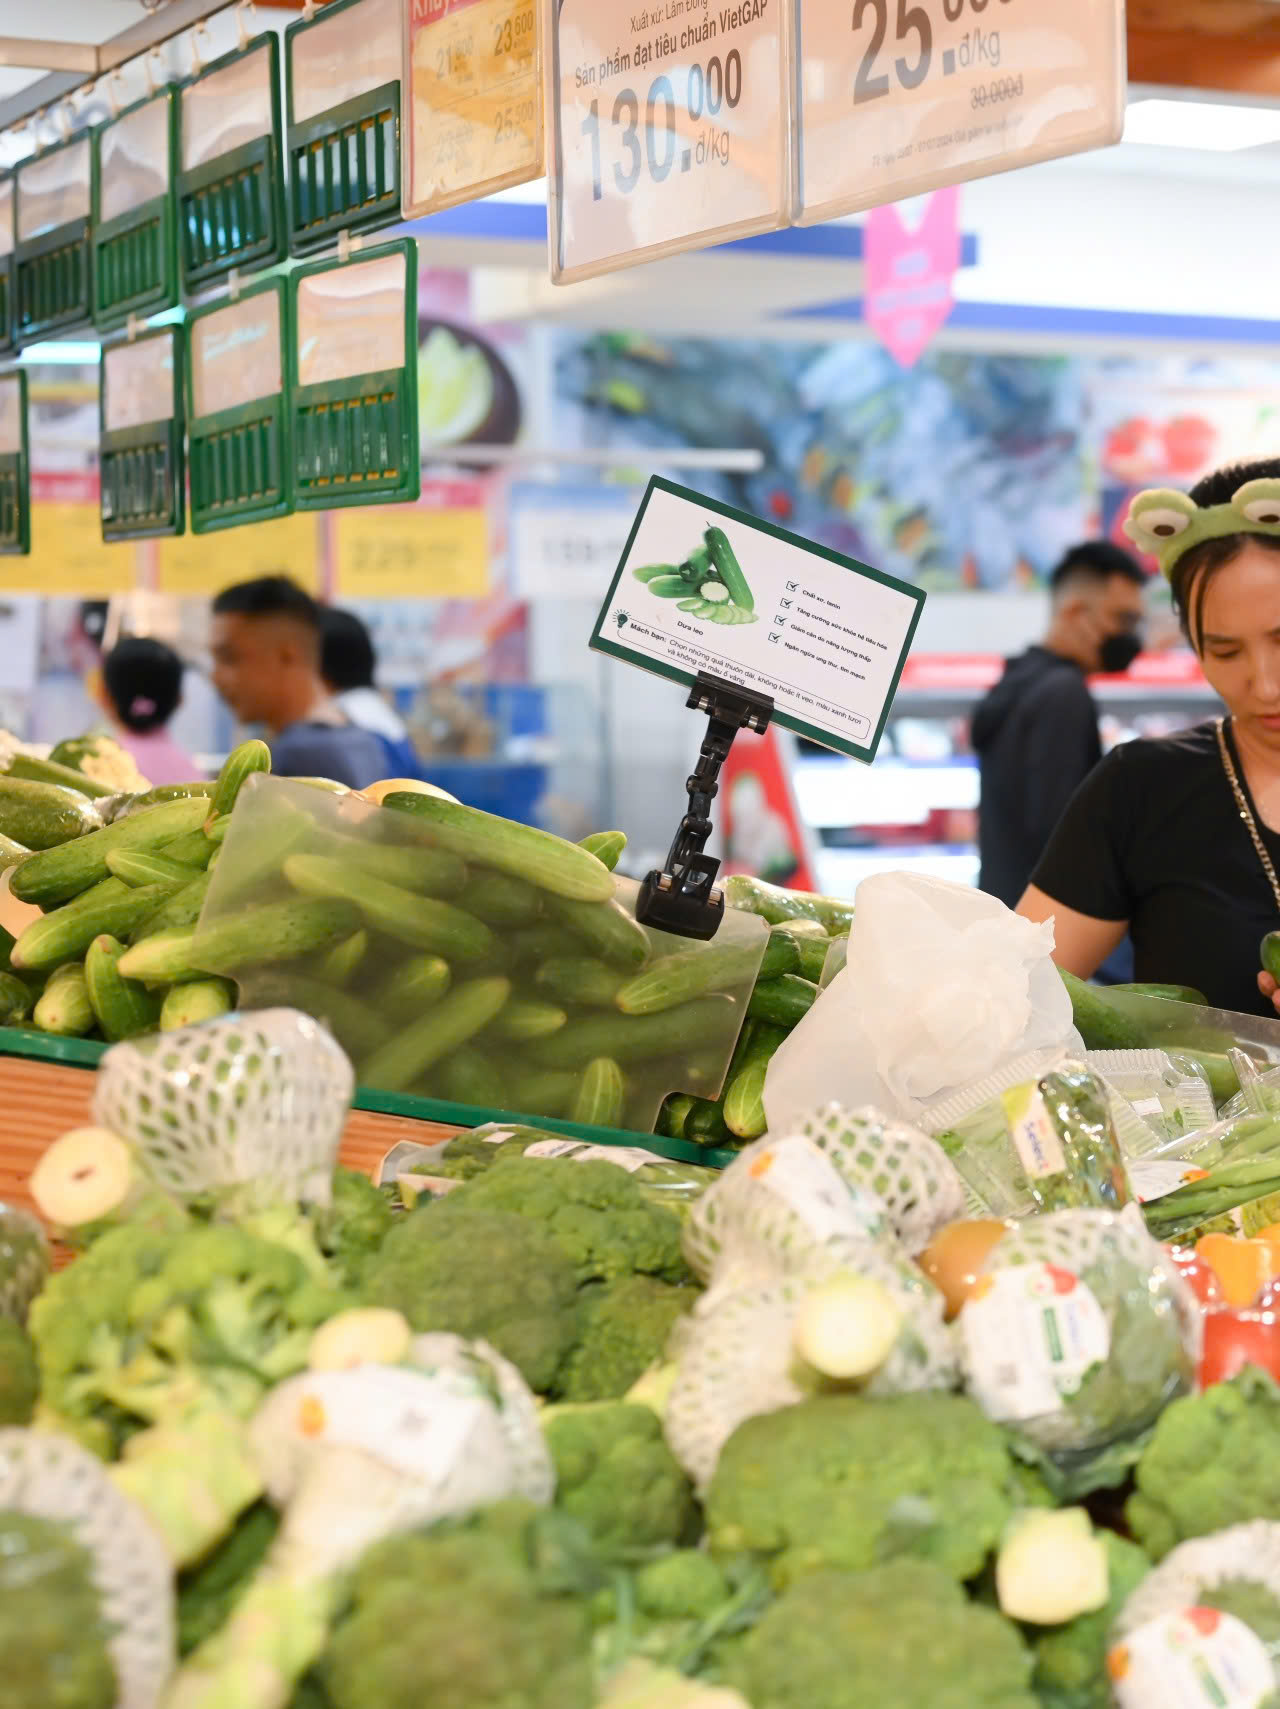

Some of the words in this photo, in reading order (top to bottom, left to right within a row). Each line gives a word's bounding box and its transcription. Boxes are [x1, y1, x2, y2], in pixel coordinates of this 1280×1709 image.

[630, 9, 649, 33] Xuất
[666, 0, 684, 20] Lâm
[575, 65, 596, 88] Sản
[599, 45, 631, 85] phẩm
[633, 42, 652, 70] đạt
[655, 33, 677, 58] tiêu
[680, 12, 717, 49] chuẩn
[719, 0, 768, 33] VietGAP
[958, 27, 1001, 67] đ/kg
[695, 128, 730, 167] đ/kg
[797, 607, 811, 617] Tăng
[802, 590, 816, 599] Chất
[677, 620, 692, 631] Dưa
[693, 627, 704, 636] leo
[630, 622, 650, 636] Mách
[651, 630, 667, 643] bạn:
[669, 639, 688, 651] Chọn
[688, 647, 710, 661] những
[711, 656, 724, 667] quả
[725, 662, 744, 674] thuôn
[758, 676, 778, 690] không
[778, 682, 795, 696] hoặc
[816, 701, 830, 712] màu
[831, 708, 847, 719] xanh
[847, 715, 861, 725] tươi
[667, 648, 676, 656] và
[677, 651, 698, 666] không
[698, 660, 706, 668] có
[707, 664, 723, 675] màu
[729, 674, 745, 685] vàng
